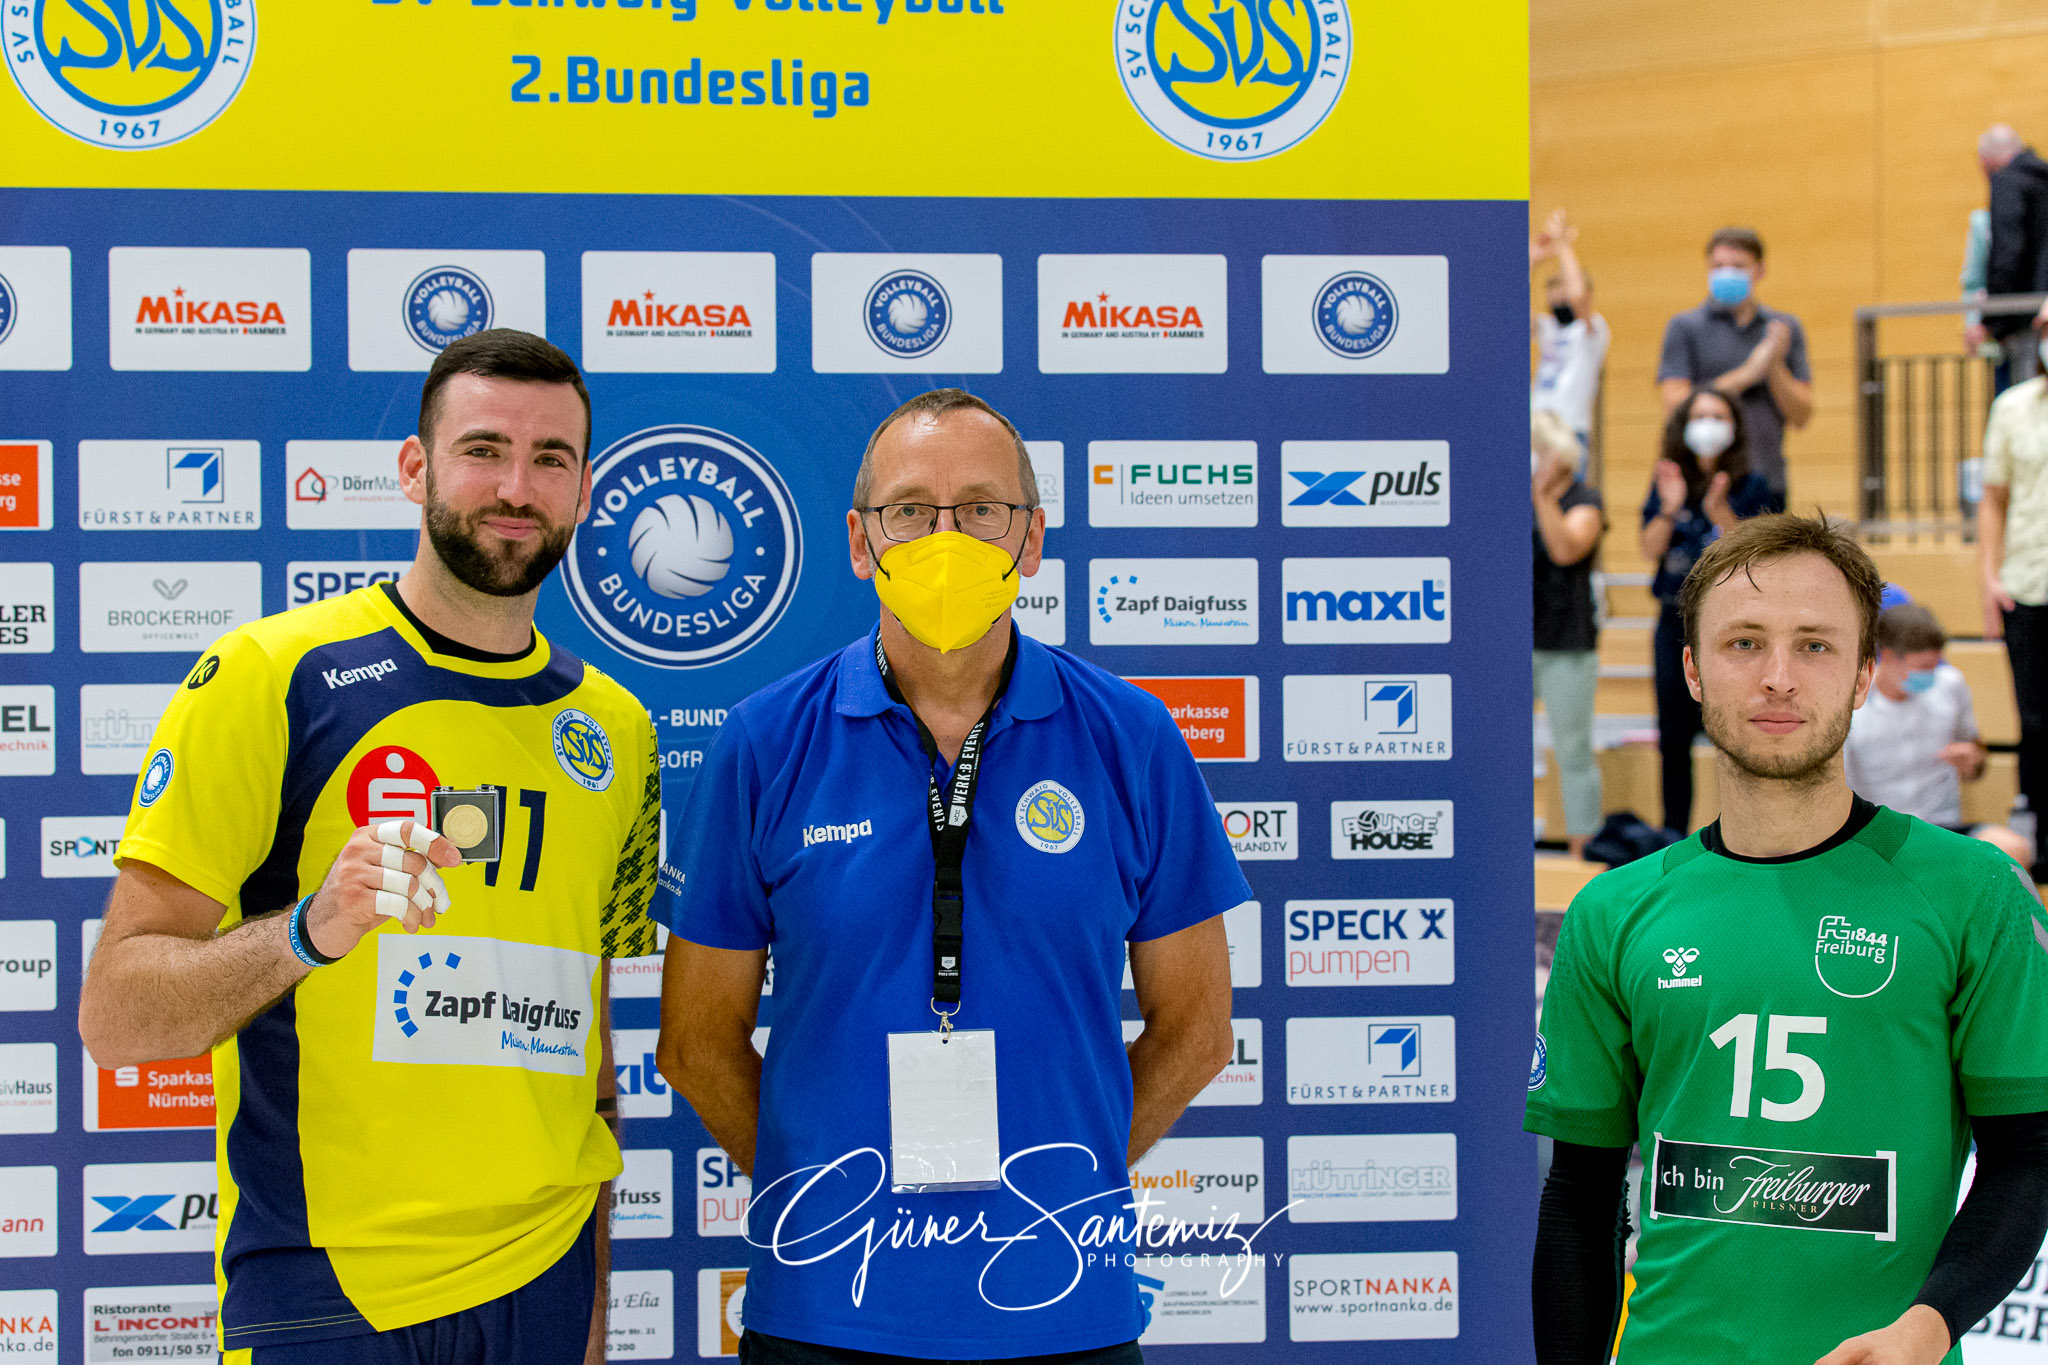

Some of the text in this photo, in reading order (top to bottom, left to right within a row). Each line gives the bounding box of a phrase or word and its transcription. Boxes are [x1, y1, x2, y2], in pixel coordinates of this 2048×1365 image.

[511, 54, 869, 118] 2.Bundesliga
[100, 120, 160, 139] 1967
[1207, 132, 1263, 151] 1967
[415, 275, 481, 305] VOLLEYBALL
[874, 280, 939, 308] VOLLEYBALL
[1323, 281, 1386, 309] VOLLEYBALL
[876, 323, 939, 349] BUNDESLIGA
[1325, 324, 1386, 350] BUNDESLIGA
[1131, 465, 1253, 484] FUCHS
[1369, 461, 1441, 505] puls
[592, 457, 764, 528] VOLLEYBALL
[1130, 491, 1253, 505] Ideen umsetzen
[83, 509, 144, 524] FÜRST
[167, 511, 255, 524] PARTNER
[599, 573, 766, 638] BUNDESLIGA
[1116, 596, 1247, 614] Zapf Daigfuss
[1287, 580, 1445, 621] maxit
[108, 610, 233, 626] BROCKERHOF
[322, 657, 398, 689] Kempa
[961, 721, 985, 759] EVENTS
[1287, 740, 1342, 755] FÜRST
[1365, 741, 1446, 754] PARTNER
[951, 763, 973, 804] WERK:B
[1020, 783, 1049, 812] SCHWAIG
[803, 819, 873, 848] Kempa
[1040, 842, 1058, 850] 1967
[1351, 832, 1433, 850] HOUSE
[1289, 909, 1409, 941] SPECK
[1851, 928, 1887, 946] 1844
[1815, 940, 1887, 964] Freiburg
[1290, 950, 1410, 982] pumpen
[1658, 975, 1702, 990] hummel
[425, 990, 581, 1032] Zapf Daigfuss
[1709, 1013, 1828, 1122] 15
[1291, 1084, 1346, 1099] FÜRST
[1369, 1084, 1449, 1098] PARTNER
[1292, 1160, 1451, 1191] HÜTTINGER
[1694, 1167, 1724, 1190] bin
[1714, 1155, 1870, 1222] Freiburger
[1753, 1200, 1818, 1213] PILSNER
[1294, 1276, 1452, 1297] SPORTNANKA
[94, 1303, 171, 1315] Ristorante
[624, 1291, 660, 1308] Elia
[1294, 1296, 1453, 1317] www.sportnanka.de
[113, 1344, 211, 1357] fon 0911/50 57
[617, 1343, 636, 1351] 200
